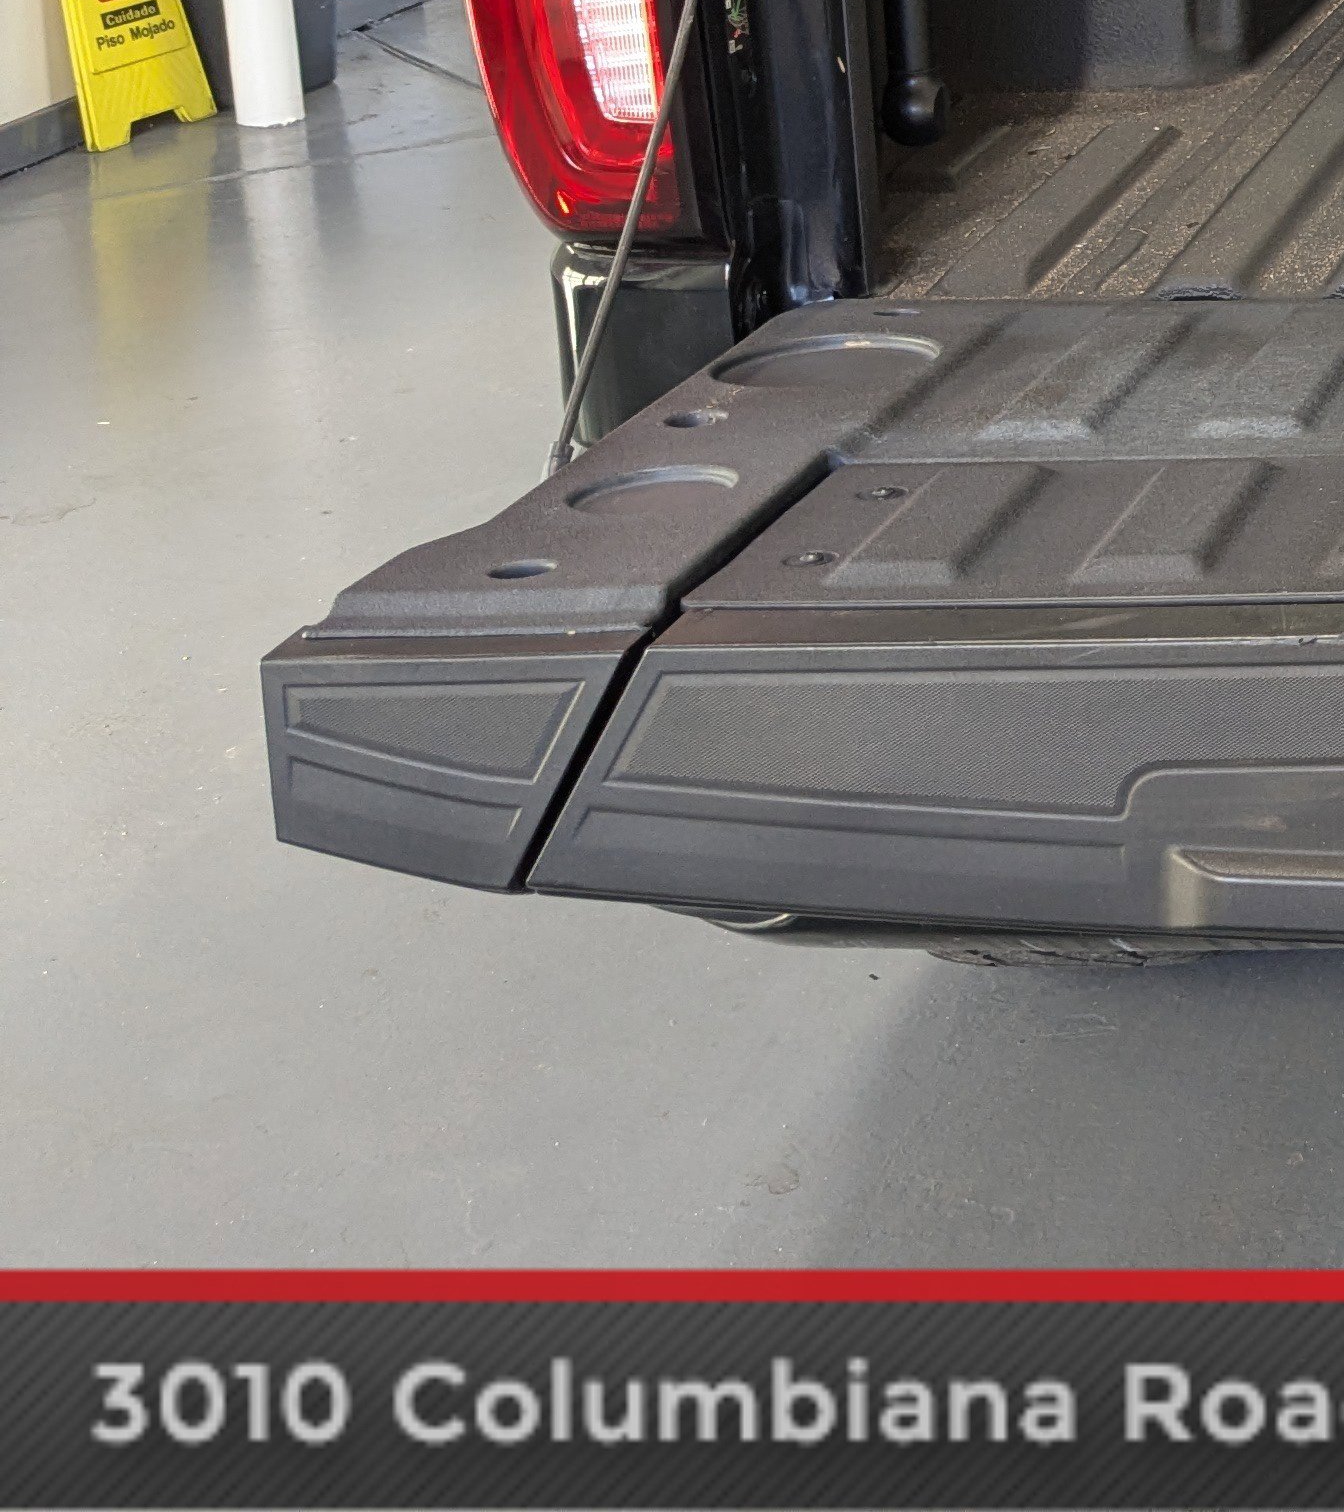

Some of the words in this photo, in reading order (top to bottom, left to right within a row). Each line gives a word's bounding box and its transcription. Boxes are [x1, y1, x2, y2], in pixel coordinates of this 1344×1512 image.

[105, 4, 156, 26] Cuidado
[96, 34, 125, 52] Piso
[129, 19, 175, 41] Mojado
